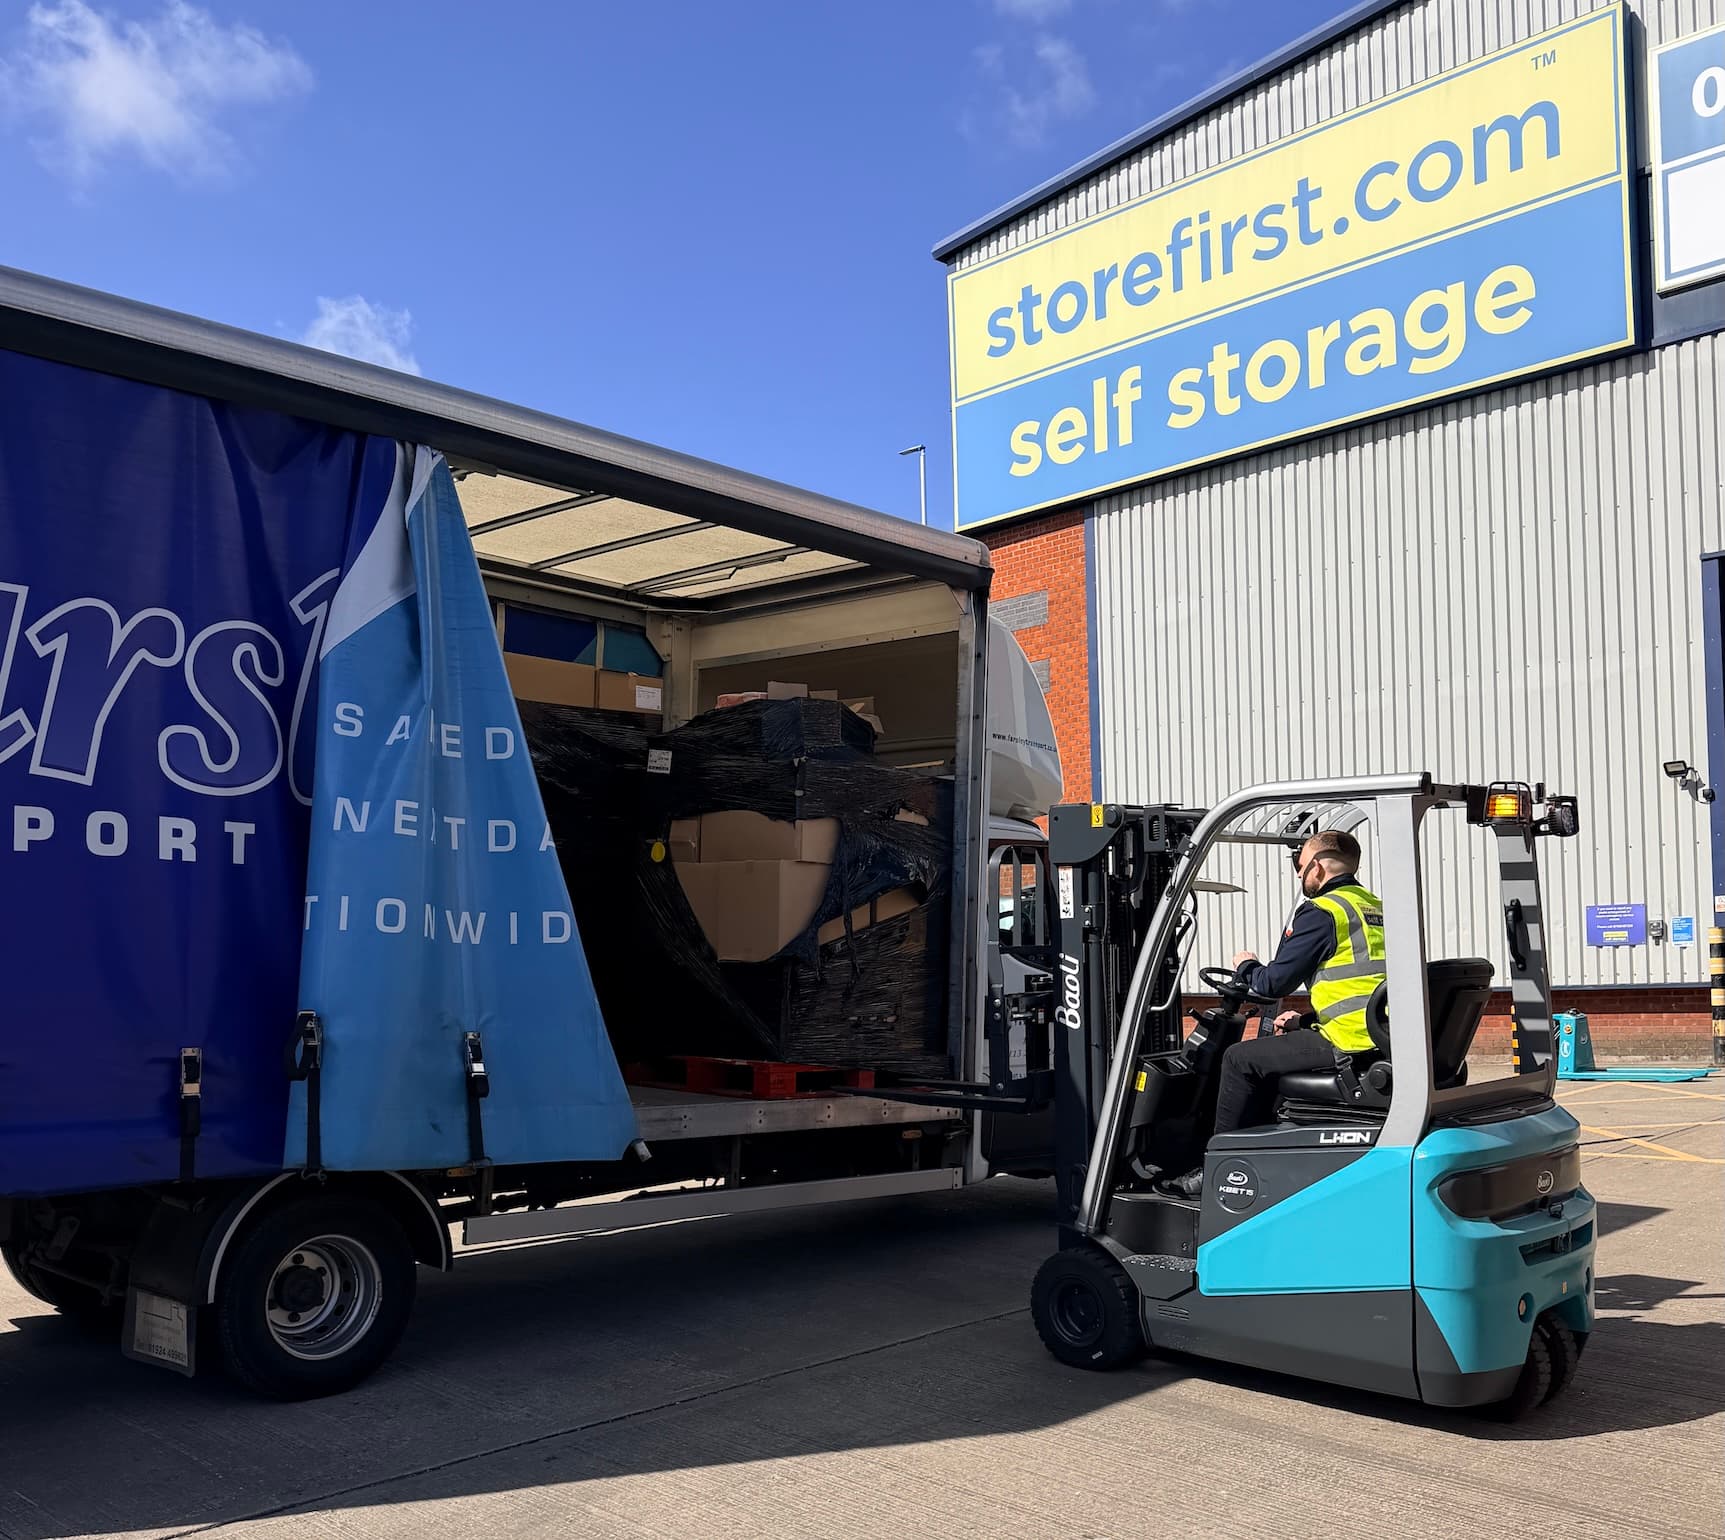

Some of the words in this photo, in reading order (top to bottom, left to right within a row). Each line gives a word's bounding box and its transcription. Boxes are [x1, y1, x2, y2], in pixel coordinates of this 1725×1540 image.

[1531, 49, 1557, 69] TM
[985, 99, 1561, 358] storefirst.com
[1008, 365, 1144, 477] self
[1166, 263, 1537, 431] storage
[1055, 952, 1081, 1030] Baoli
